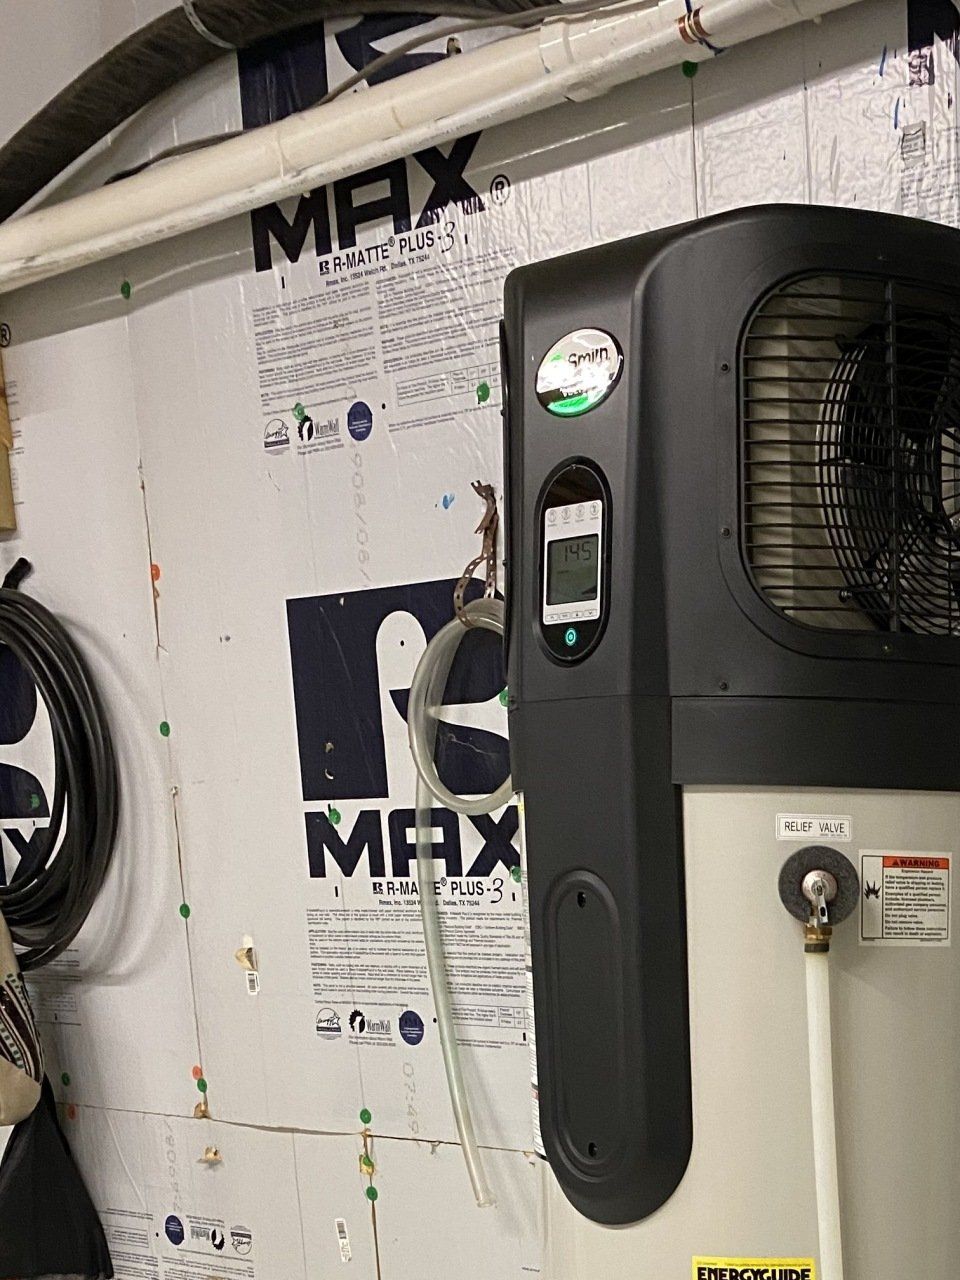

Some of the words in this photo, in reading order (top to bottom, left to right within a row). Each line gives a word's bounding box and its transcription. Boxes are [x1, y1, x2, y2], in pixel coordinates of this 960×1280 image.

[563, 541, 592, 562] 145
[784, 821, 813, 832] RELIEF
[819, 822, 845, 834] VALVE
[900, 859, 940, 868] WARNING
